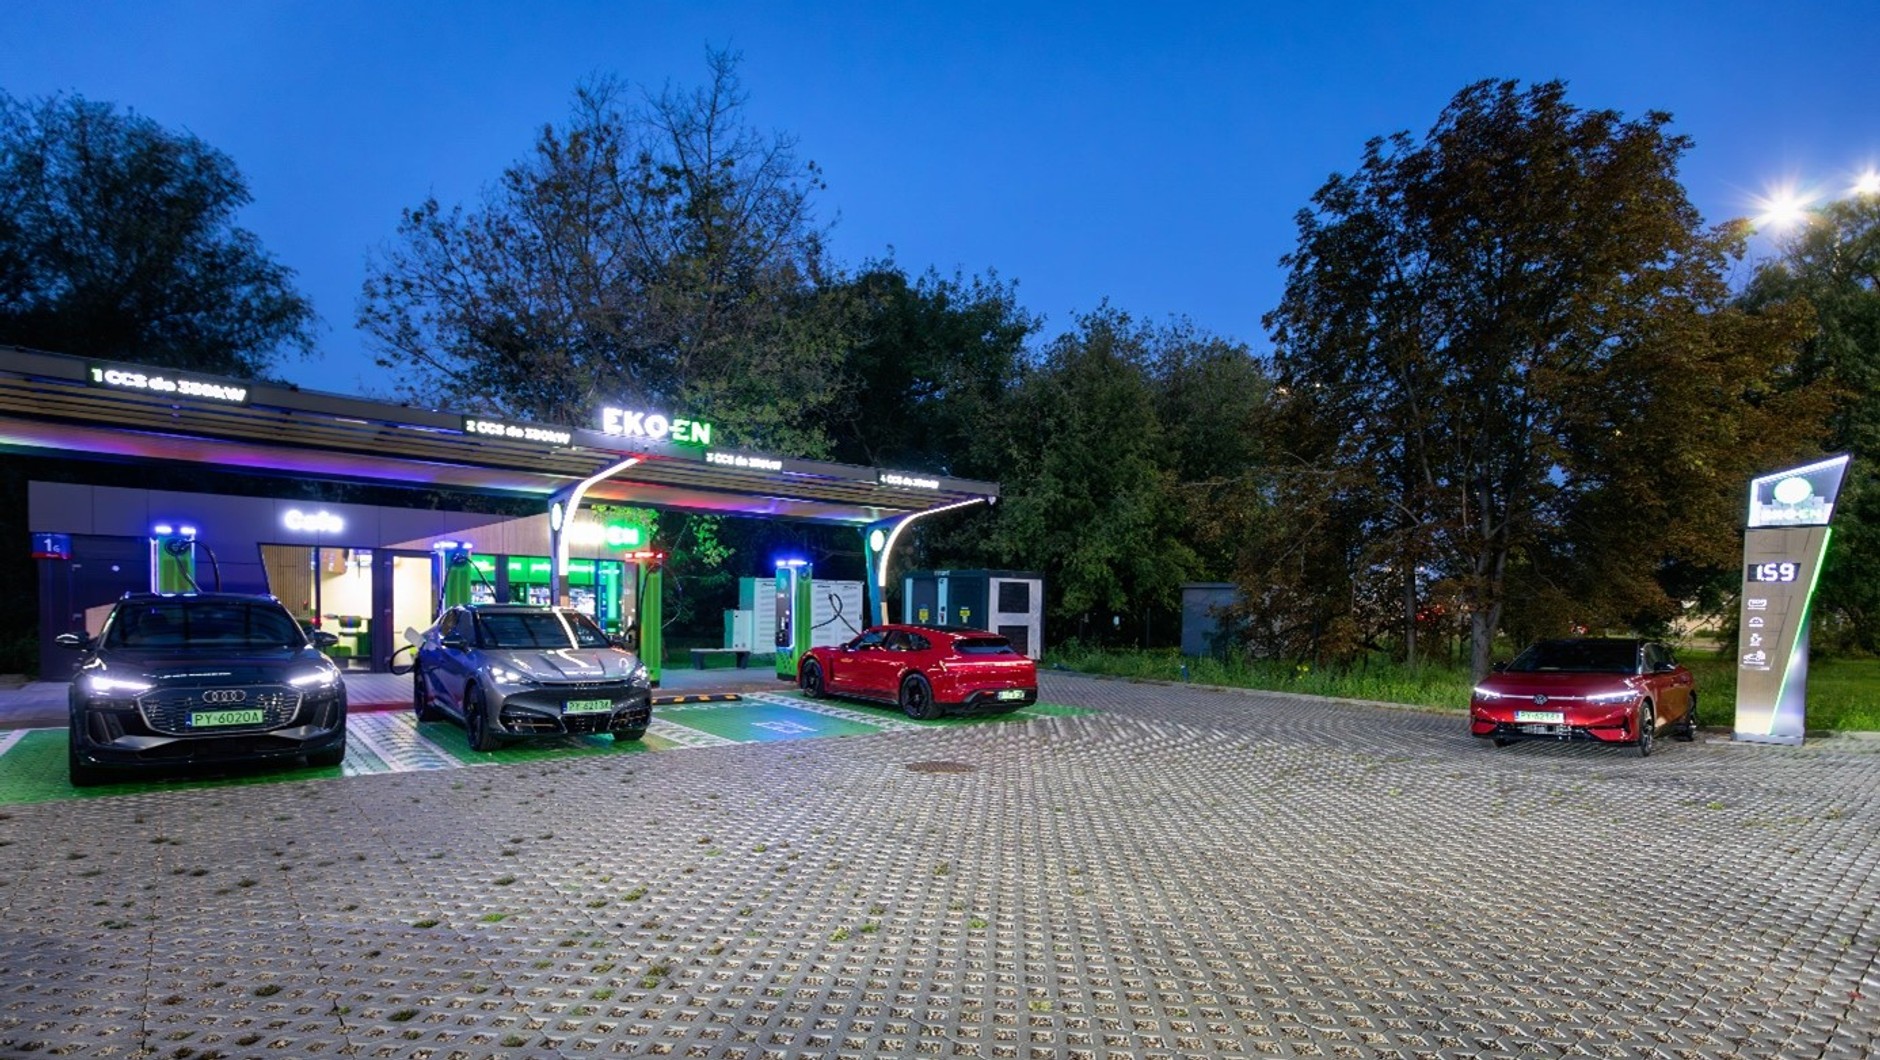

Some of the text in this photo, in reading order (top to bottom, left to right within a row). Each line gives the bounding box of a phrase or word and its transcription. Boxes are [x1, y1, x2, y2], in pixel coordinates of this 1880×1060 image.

[91, 368, 103, 382] 1
[104, 370, 148, 388] CCS
[466, 420, 476, 432] 2
[477, 421, 505, 436] CCS
[195, 711, 259, 725] PY 6020A
